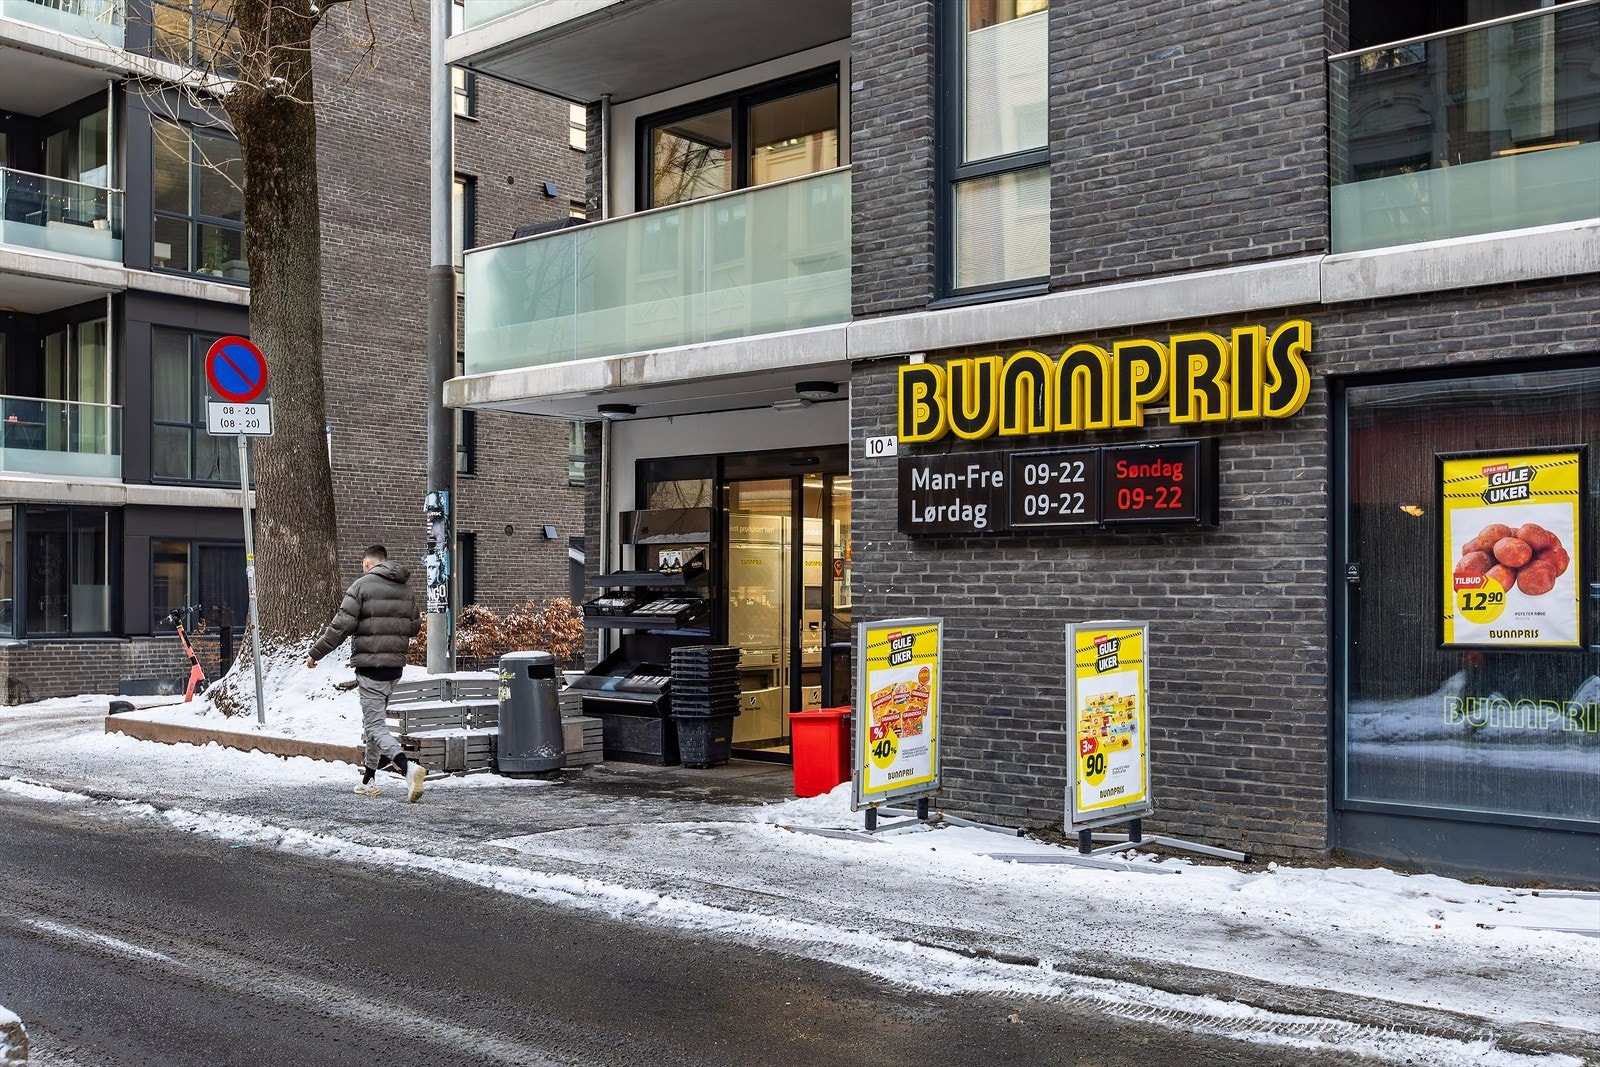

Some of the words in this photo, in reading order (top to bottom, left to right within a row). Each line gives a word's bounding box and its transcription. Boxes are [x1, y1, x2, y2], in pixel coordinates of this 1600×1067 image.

[898, 320, 1312, 443] BUNNPRIS
[223, 406, 234, 415] 08
[245, 407, 256, 415] 20
[220, 418, 235, 428] (08
[246, 419, 260, 429] 20)
[870, 439, 884, 454] 10
[887, 438, 893, 447] A
[911, 464, 1004, 491] Man-Fre
[1024, 461, 1085, 485] 09-22
[1116, 458, 1184, 482] Søndag
[1492, 469, 1529, 486] GULE
[1490, 485, 1528, 502] UKER
[911, 498, 988, 529] Lørdag
[1024, 492, 1085, 516] 09-22
[1117, 486, 1182, 510] 09-22
[1455, 577, 1481, 585] TILBUD
[1489, 629, 1539, 639] BUNNPRIS
[892, 635, 912, 650] GULE
[1099, 640, 1118, 655] GULE
[891, 650, 912, 665] UKER
[1098, 655, 1118, 671] UKER
[873, 727, 883, 739] %
[872, 740, 897, 758] -40%
[888, 768, 914, 780] BUNNPRIS
[1099, 785, 1125, 799] BUNNPRIS
